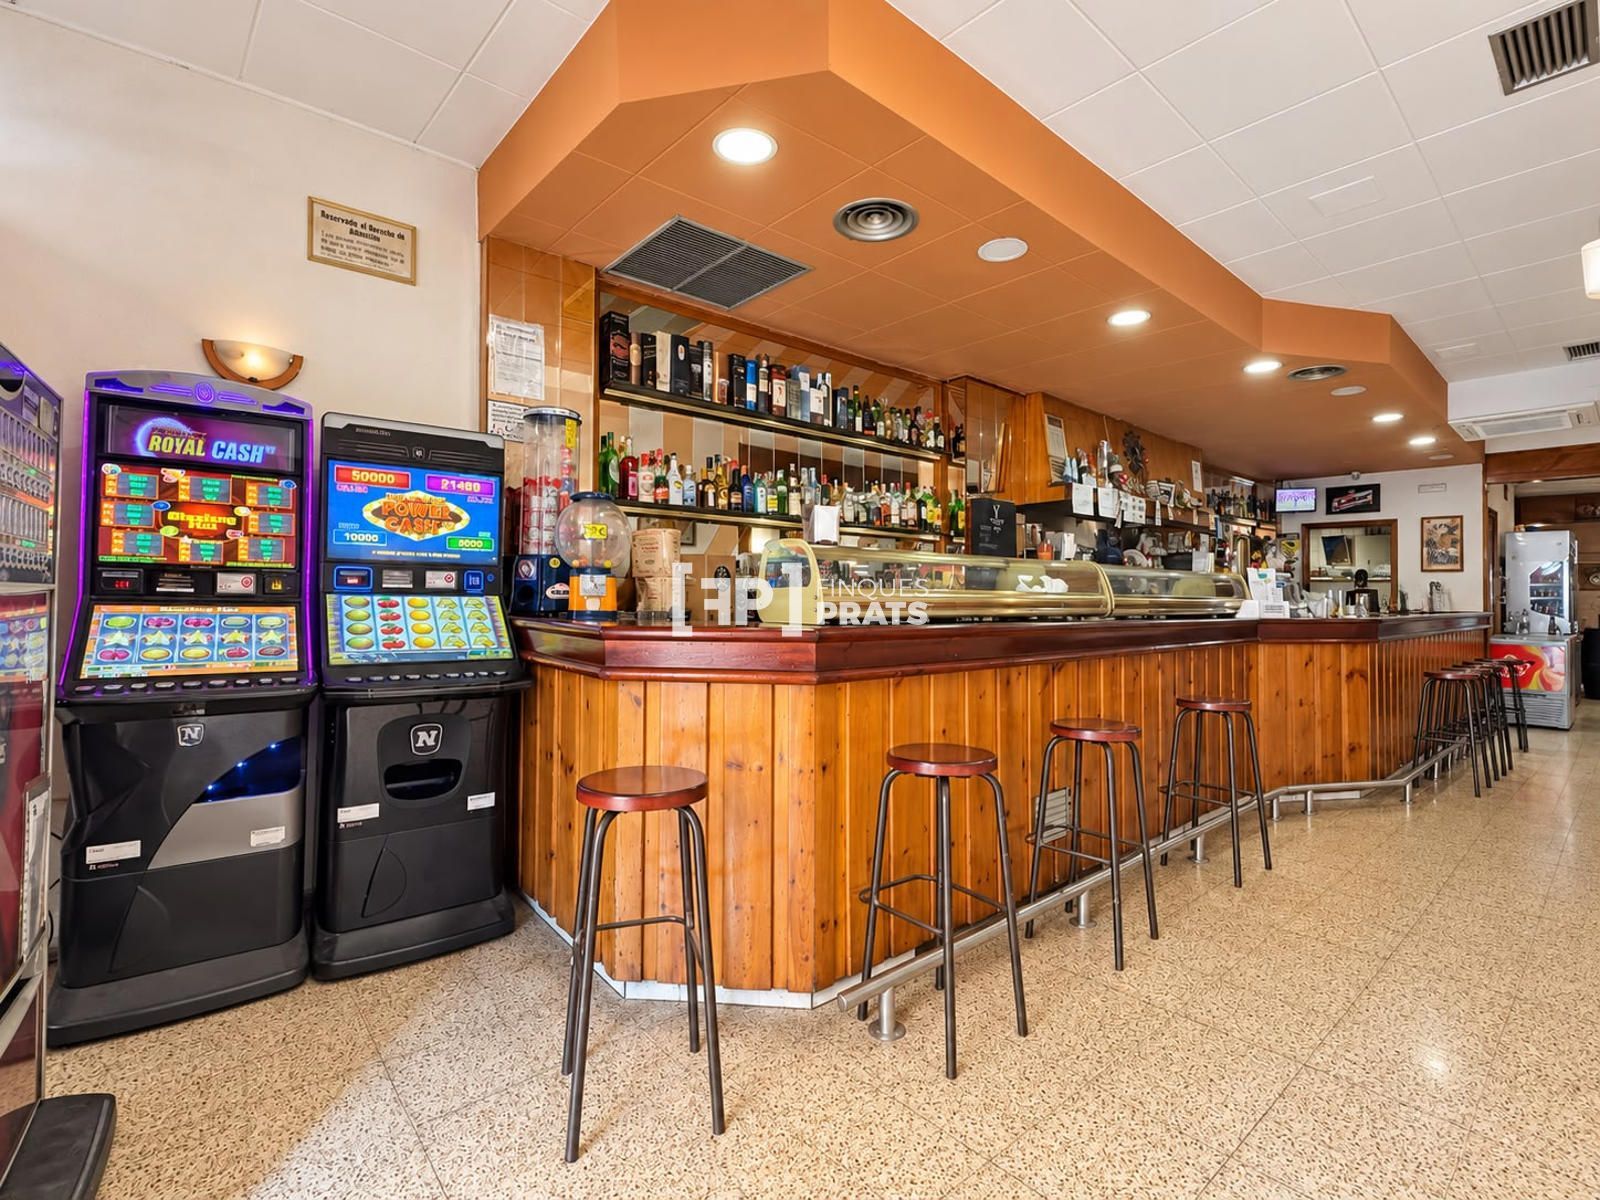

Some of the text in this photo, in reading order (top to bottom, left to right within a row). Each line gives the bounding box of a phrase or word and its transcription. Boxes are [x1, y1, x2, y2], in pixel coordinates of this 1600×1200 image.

[320, 209, 358, 228] Reservado
[148, 434, 206, 457] ROYAL
[351, 470, 395, 484] 50000
[382, 500, 452, 520] POWER
[344, 532, 379, 543] 10000
